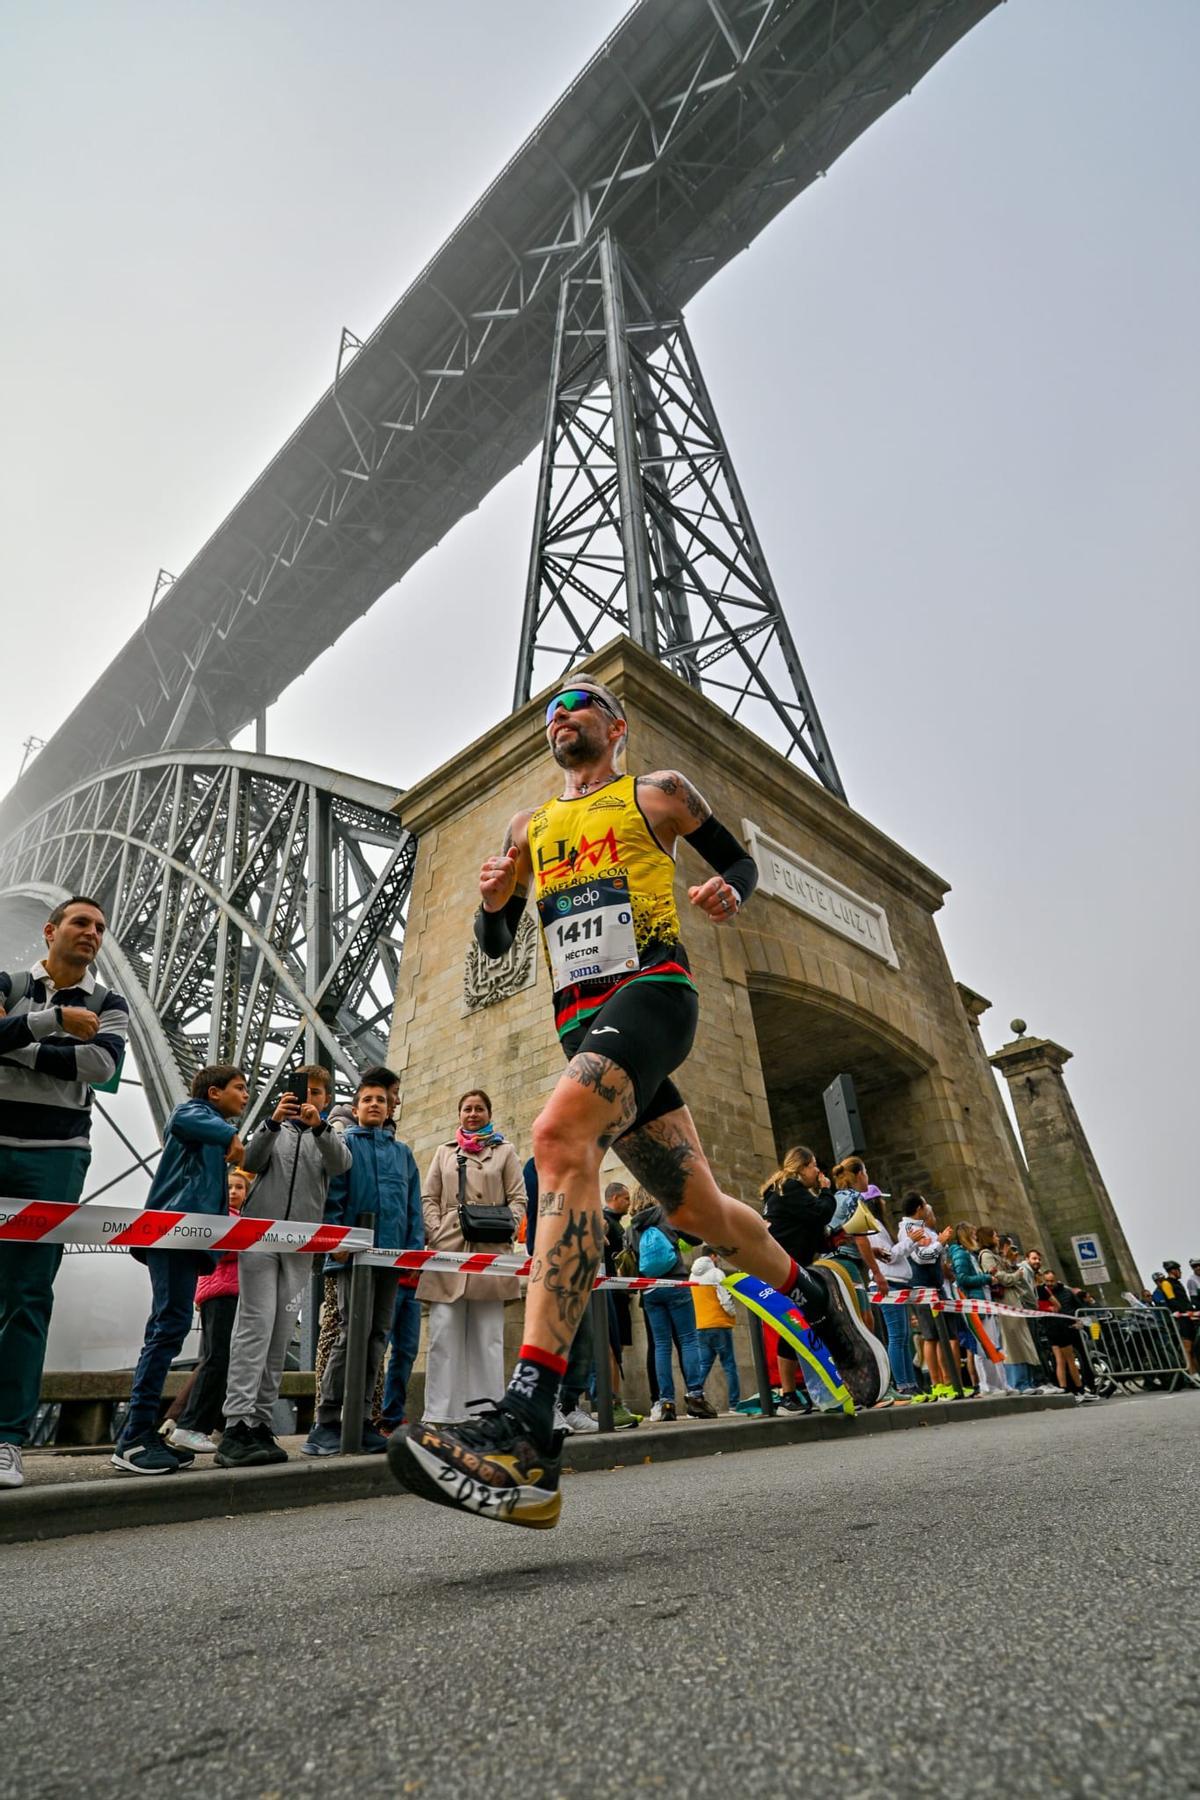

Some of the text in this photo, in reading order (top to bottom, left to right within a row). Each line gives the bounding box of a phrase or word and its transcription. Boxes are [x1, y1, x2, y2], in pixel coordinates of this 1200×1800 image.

[573, 887, 600, 906] edp
[770, 857, 828, 911] PONTE
[829, 894, 865, 934] LUIZ
[557, 915, 602, 947] 1411
[565, 946, 599, 961] HÉCTOR
[102, 1222, 132, 1233] DMM
[174, 1226, 212, 1238] PORTO
